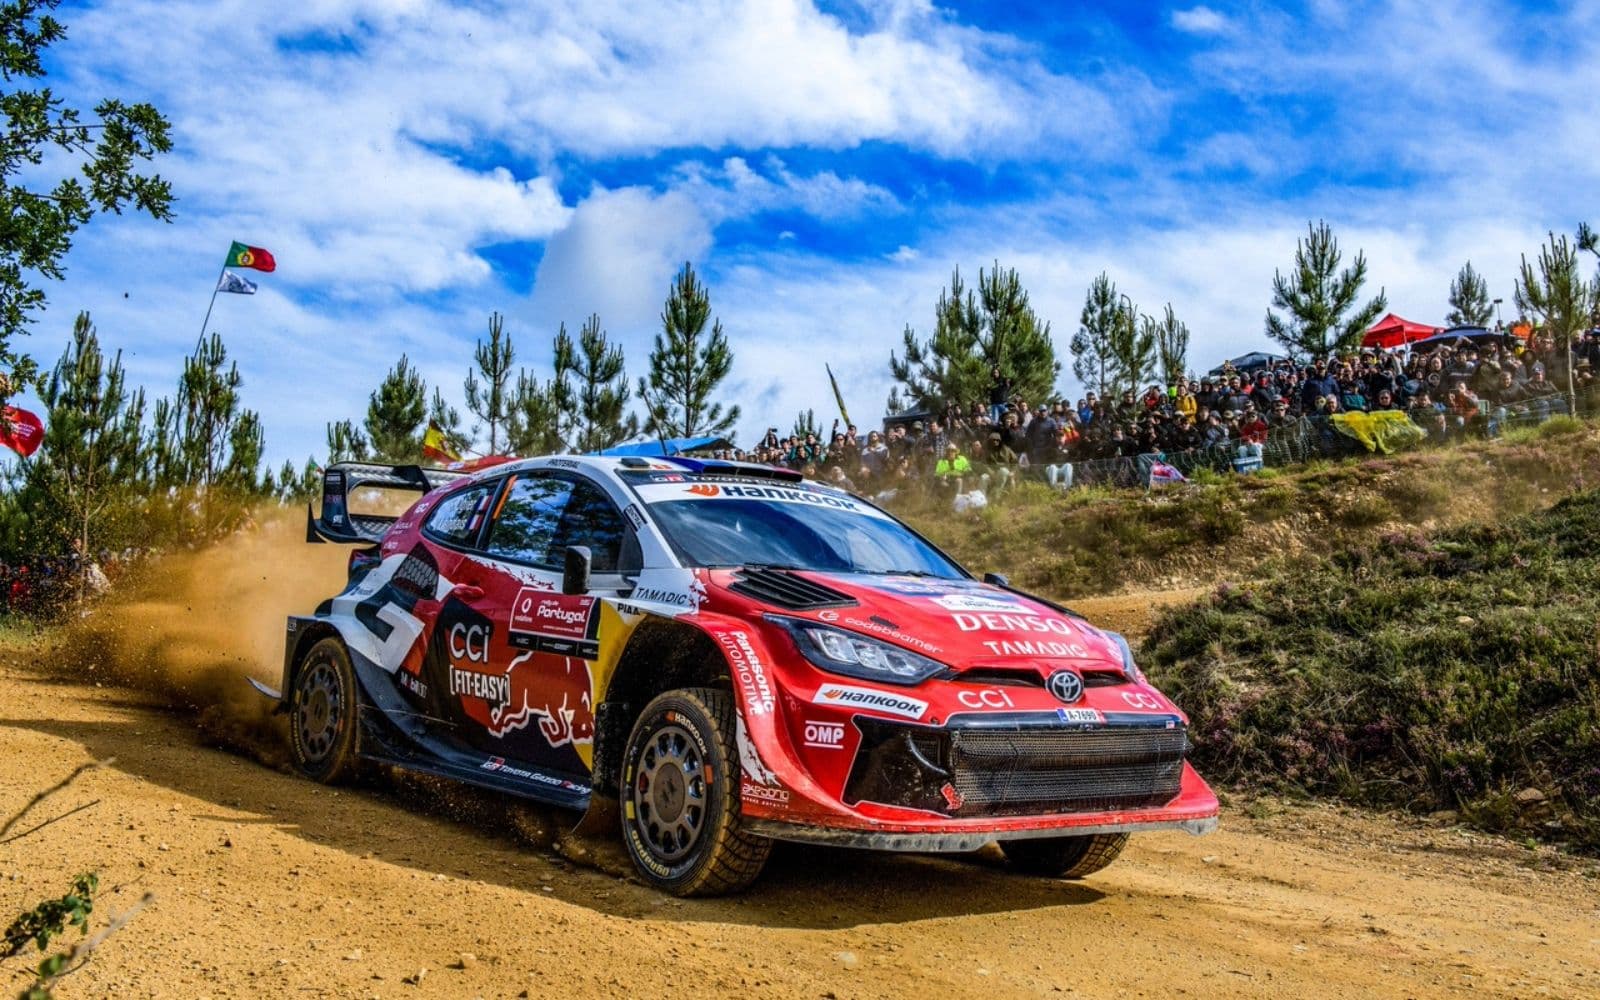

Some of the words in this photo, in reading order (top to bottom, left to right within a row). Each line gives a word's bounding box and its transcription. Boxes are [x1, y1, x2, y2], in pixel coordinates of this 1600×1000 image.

[636, 587, 688, 606] TAMADIC
[537, 604, 587, 624] Portugal
[617, 602, 641, 616] PIAA
[953, 612, 1072, 636] DENSO
[845, 617, 943, 653] codebeamer
[983, 640, 1089, 658] TAMADIC
[714, 631, 764, 716] AUTOMOTIVE
[731, 630, 776, 714] Panasonic
[804, 725, 844, 744] OMP
